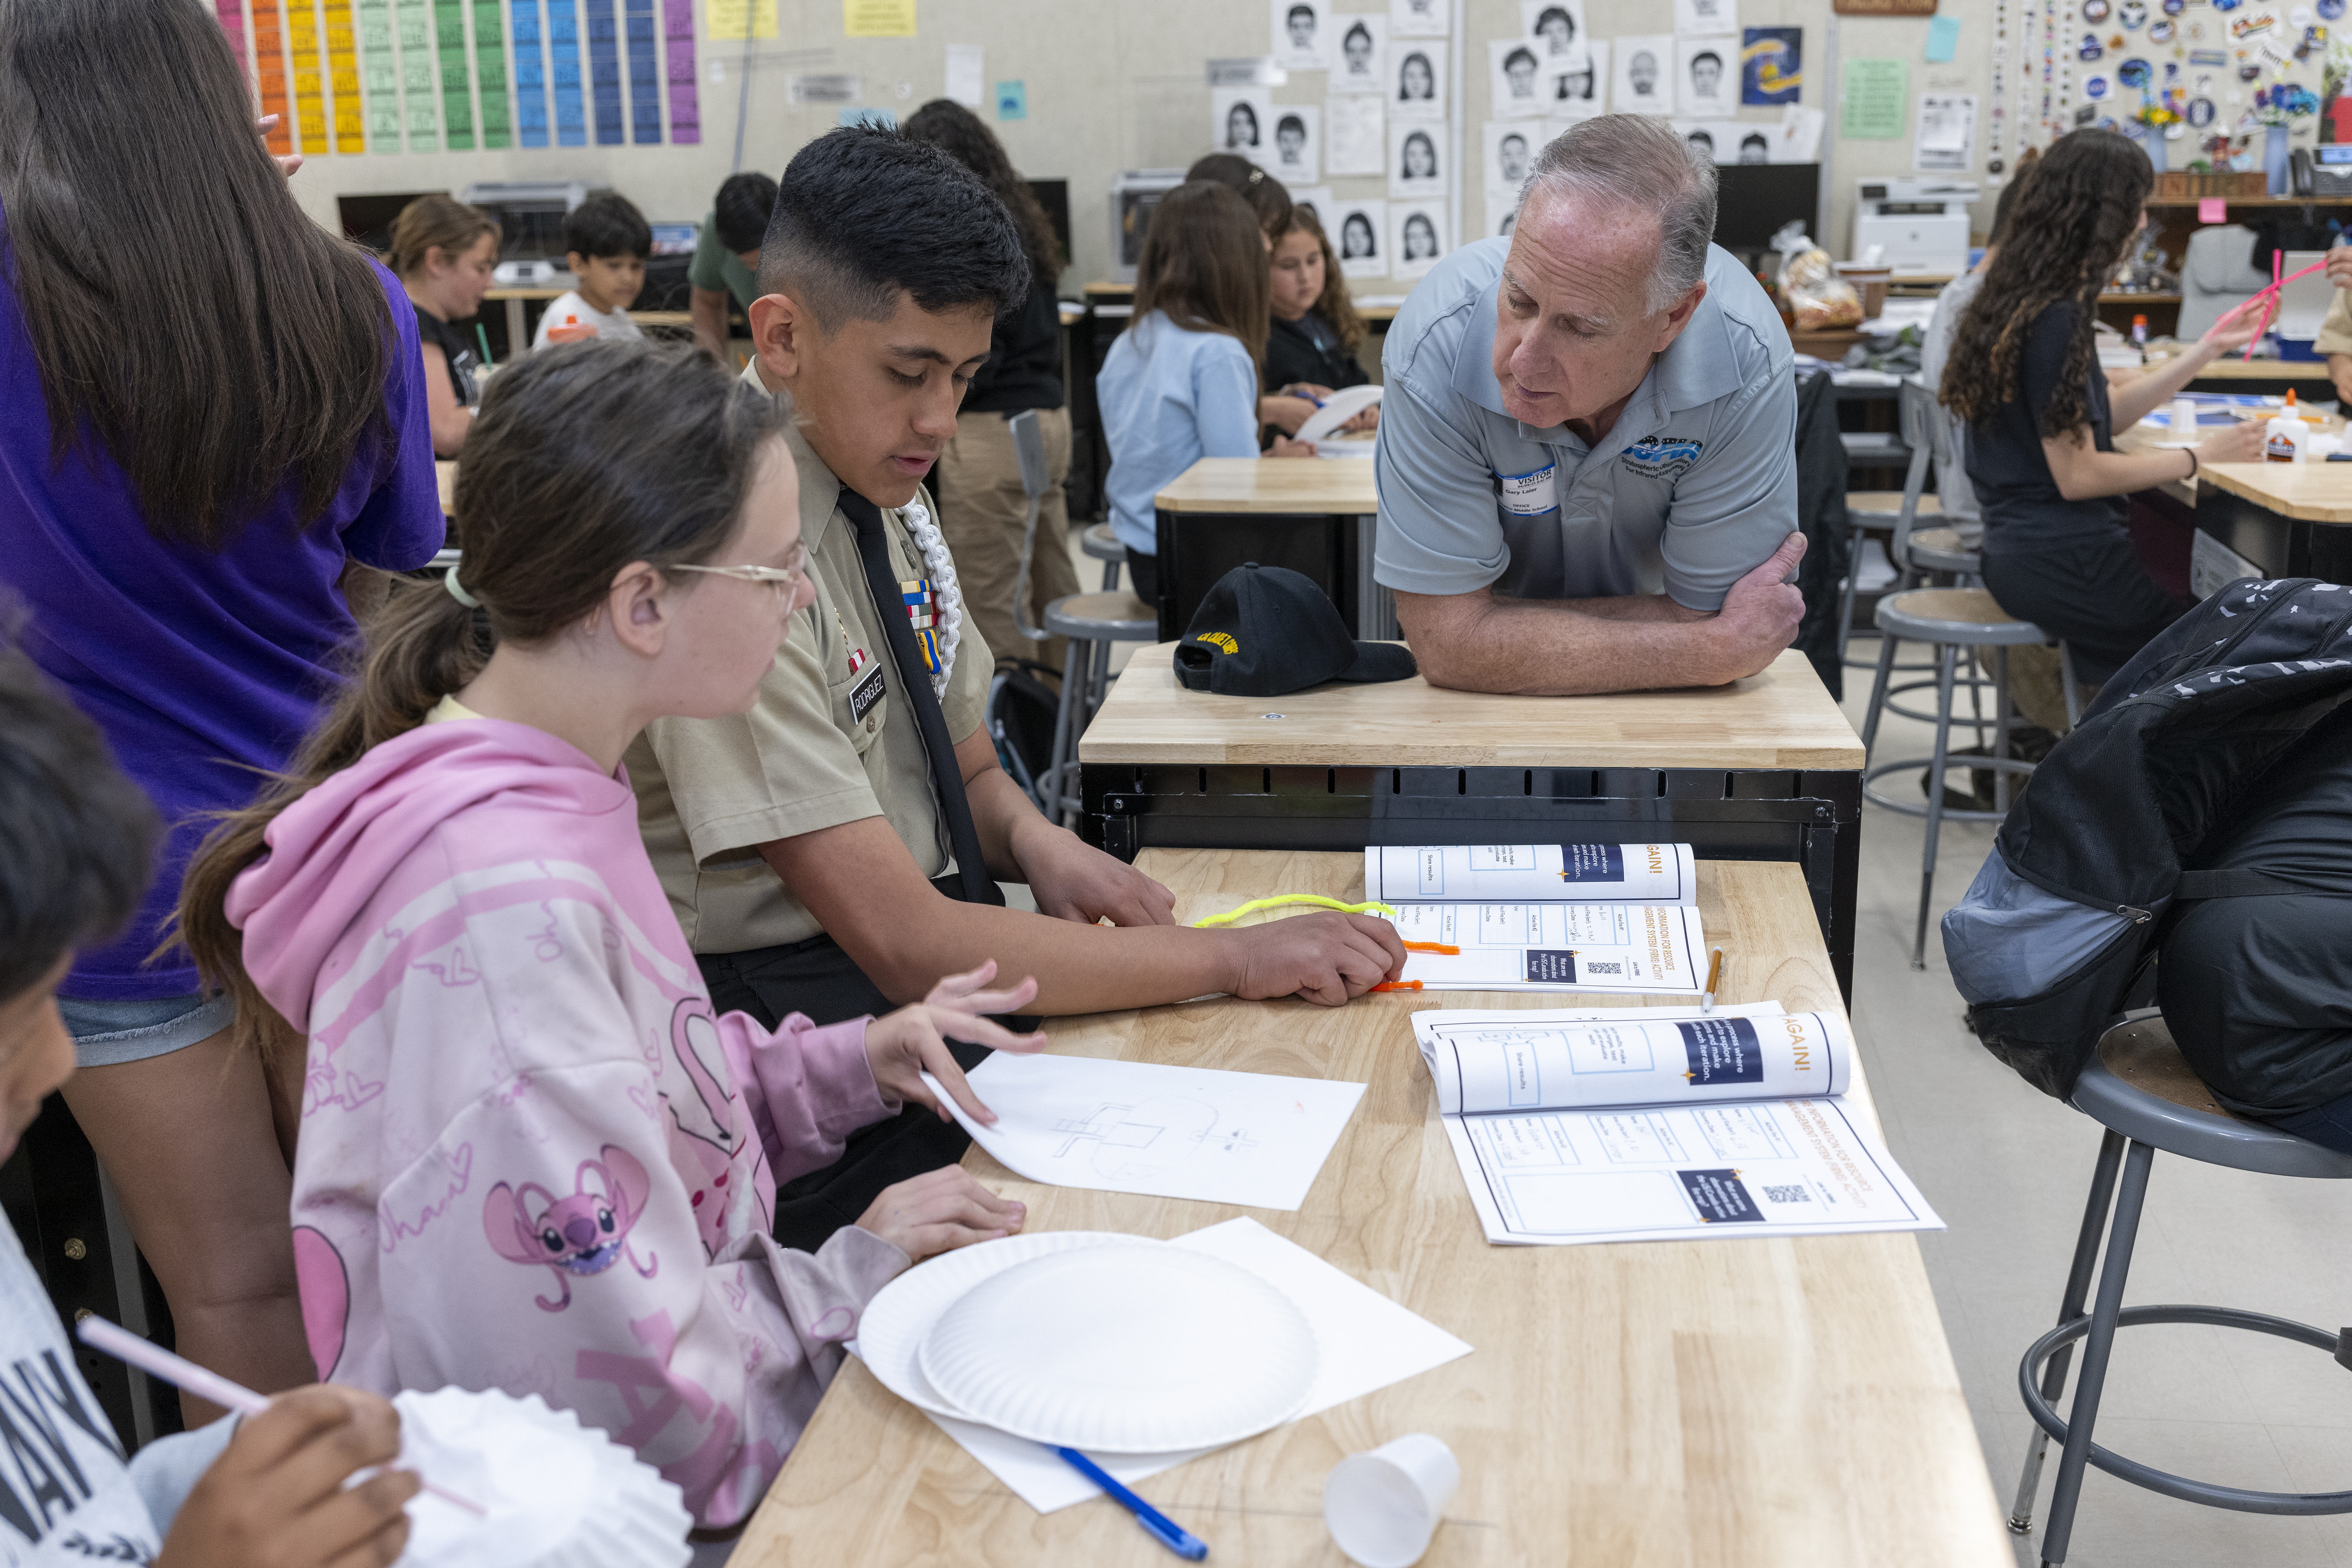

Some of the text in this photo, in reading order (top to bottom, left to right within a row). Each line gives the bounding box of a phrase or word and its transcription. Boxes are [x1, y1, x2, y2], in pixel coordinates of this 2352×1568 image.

[1621, 457, 1659, 471] Stratospheric
[1636, 469, 1658, 479] Infrared
[1518, 469, 1552, 484] VISITOR
[855, 674, 884, 714] RODRIGUEZ
[1590, 850, 1599, 866] explore
[1646, 930, 1658, 947] SYSTEM
[1657, 907, 1675, 970] INFORMATION FOR RESOURCE
[1648, 948, 1660, 963] (FIRMS)
[1651, 964, 1664, 980] ACTIVITY
[1695, 1030, 1706, 1043] each
[1707, 1034, 1719, 1045] and
[1782, 1019, 1811, 1071] AGAIN!
[1711, 1047, 1722, 1069] make
[1719, 1036, 1731, 1064] explore
[1724, 1025, 1739, 1046] process
[1734, 1047, 1744, 1073] where
[1699, 1045, 1711, 1081] iteration.
[1519, 1068, 1527, 1090] results
[1806, 1108, 1842, 1149] INFORMATION
[1834, 1150, 1851, 1161] FOR
[1810, 1139, 1834, 1160] SYSTEM
